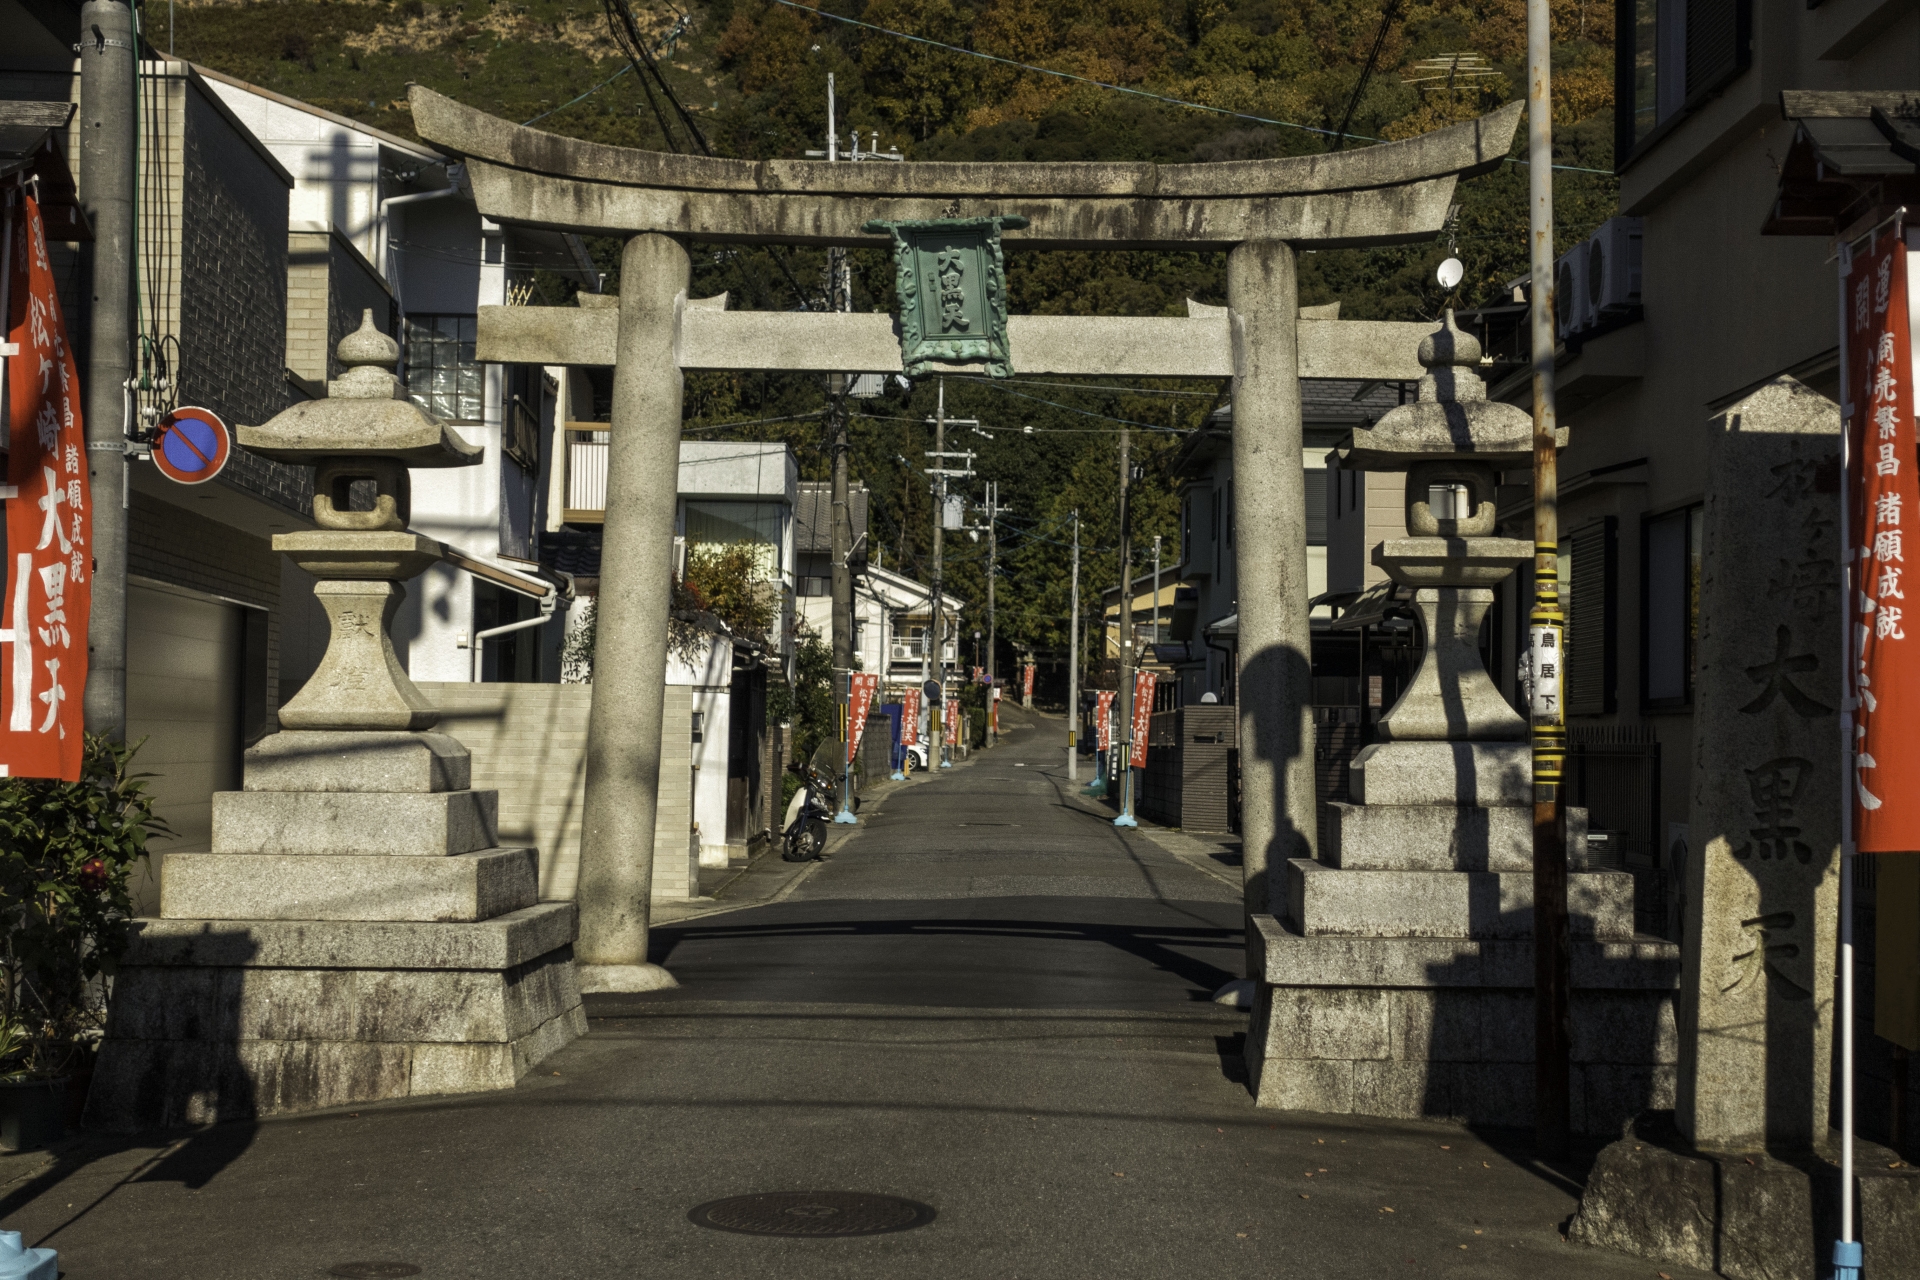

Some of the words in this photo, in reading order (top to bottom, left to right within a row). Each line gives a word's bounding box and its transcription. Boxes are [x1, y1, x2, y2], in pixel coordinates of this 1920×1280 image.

[1855, 253, 1892, 334] 開運
[1873, 329, 1901, 477] 商売繁昌
[65, 442, 85, 584] 諸願成就
[1873, 491, 1905, 640] 諸願成就
[1540, 632, 1557, 710] 鳥居下
